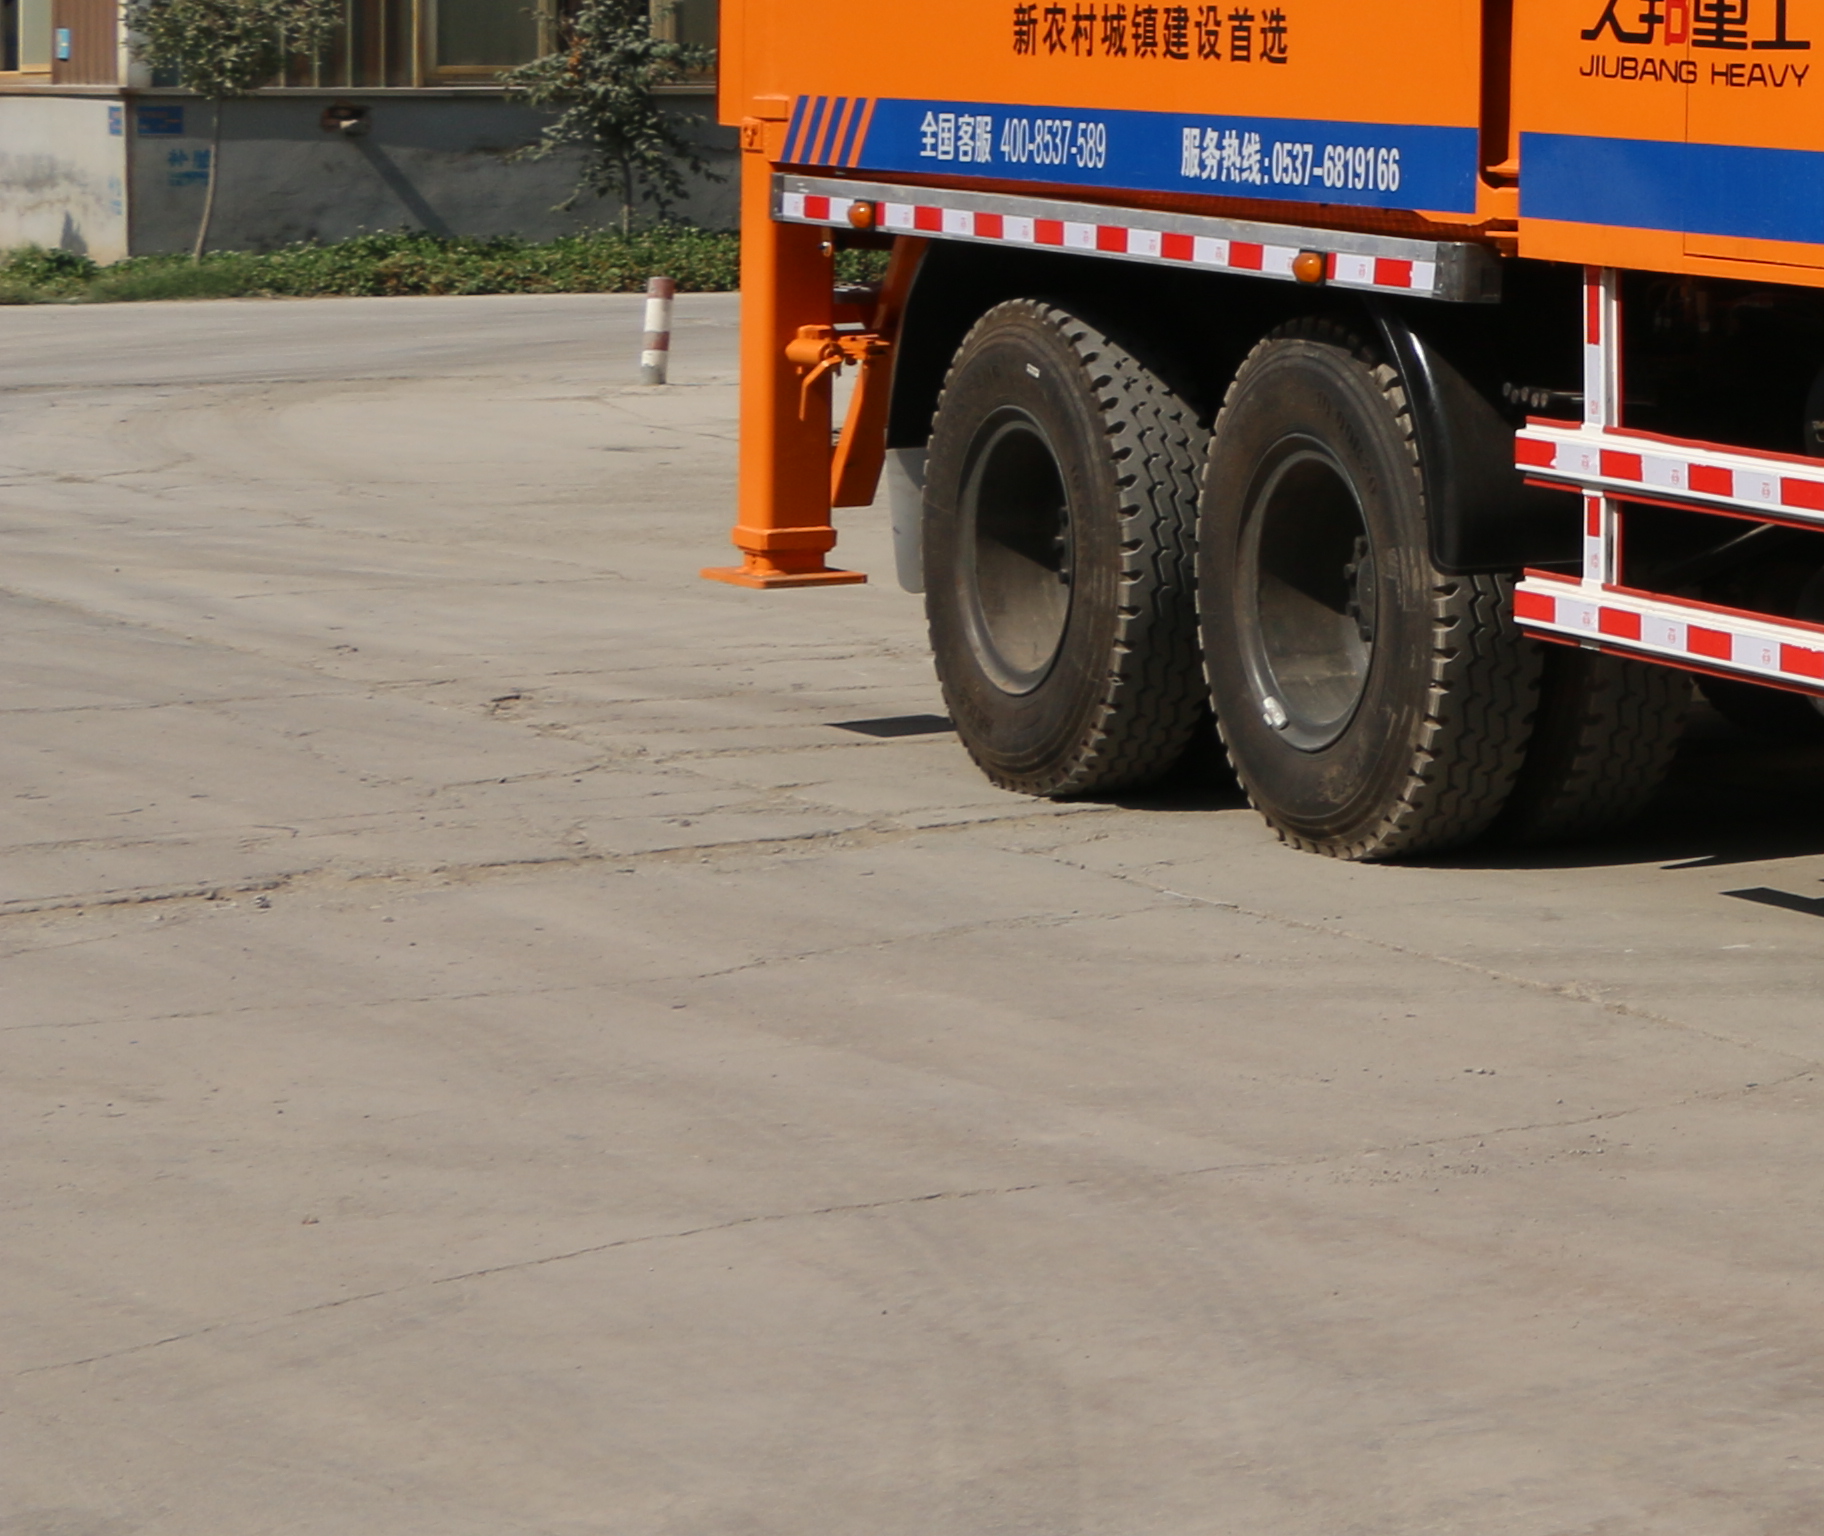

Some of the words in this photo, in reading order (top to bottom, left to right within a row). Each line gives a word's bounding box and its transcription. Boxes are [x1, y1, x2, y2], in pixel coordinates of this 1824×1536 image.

[1013, 1, 1289, 64] 新农村城镇建设首选
[1579, 56, 1697, 85] JIUBANG
[1711, 61, 1810, 89] HEAVY
[920, 111, 992, 163] 全国客服
[1000, 117, 1106, 169] 400-8537-589
